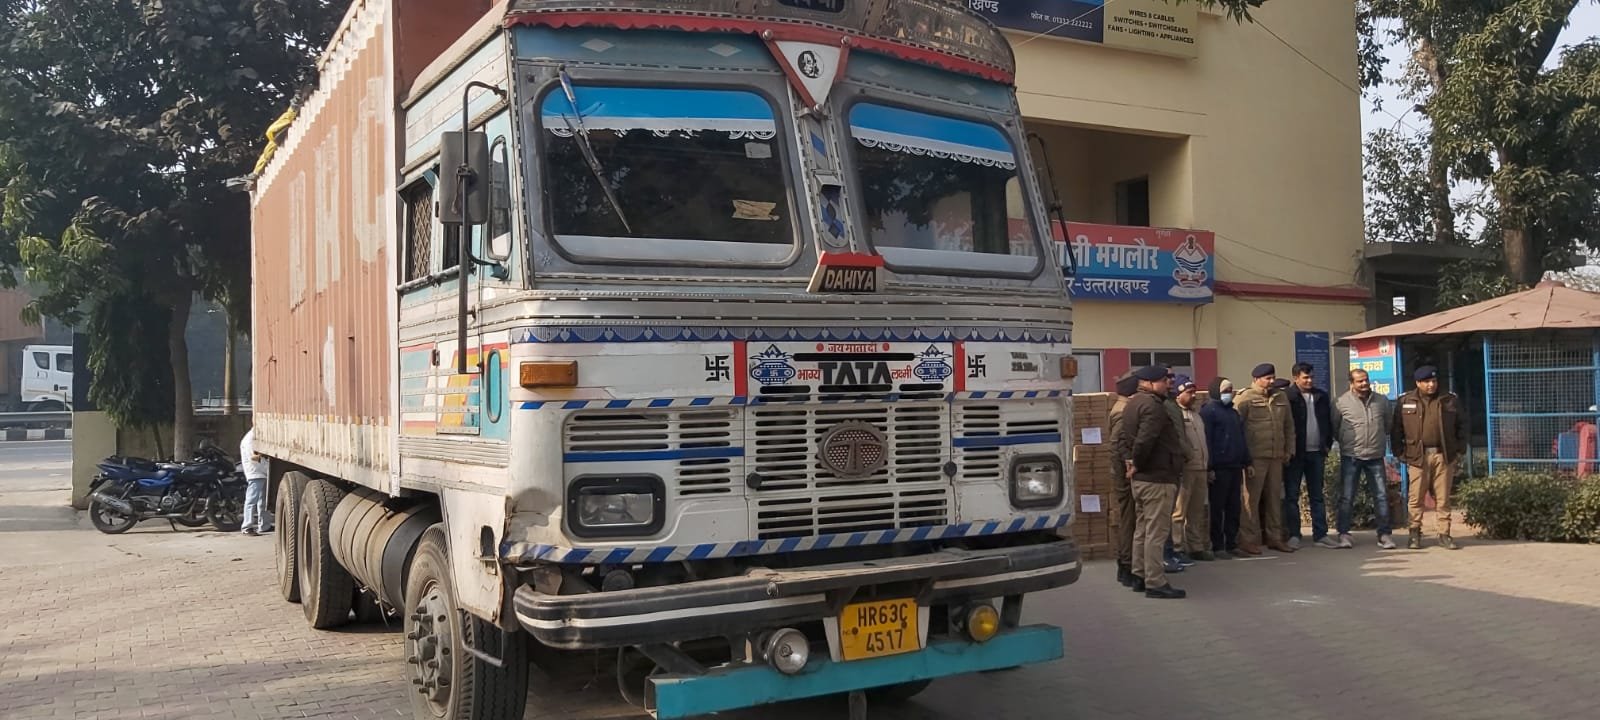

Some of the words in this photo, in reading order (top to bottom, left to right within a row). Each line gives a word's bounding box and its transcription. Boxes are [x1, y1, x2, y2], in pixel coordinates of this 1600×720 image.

[1113, 16, 1143, 27] SWITCHES
[1148, 22, 1189, 34] SWITCHGEARS
[1129, 9, 1147, 18] WIRES
[1153, 13, 1175, 23] CABLES
[1107, 24, 1123, 33] FANS
[1128, 28, 1155, 38] LIGHTING
[1159, 33, 1194, 44] APPLIANCES
[1095, 236, 1160, 270] मंगलौर
[824, 269, 874, 291] DAHIYA
[1064, 277, 1151, 297] र-उत्तराखण्ड
[796, 367, 821, 382] भाग्य
[818, 361, 893, 385] TATA
[858, 603, 908, 628] HR63C
[866, 629, 903, 653] 4517
